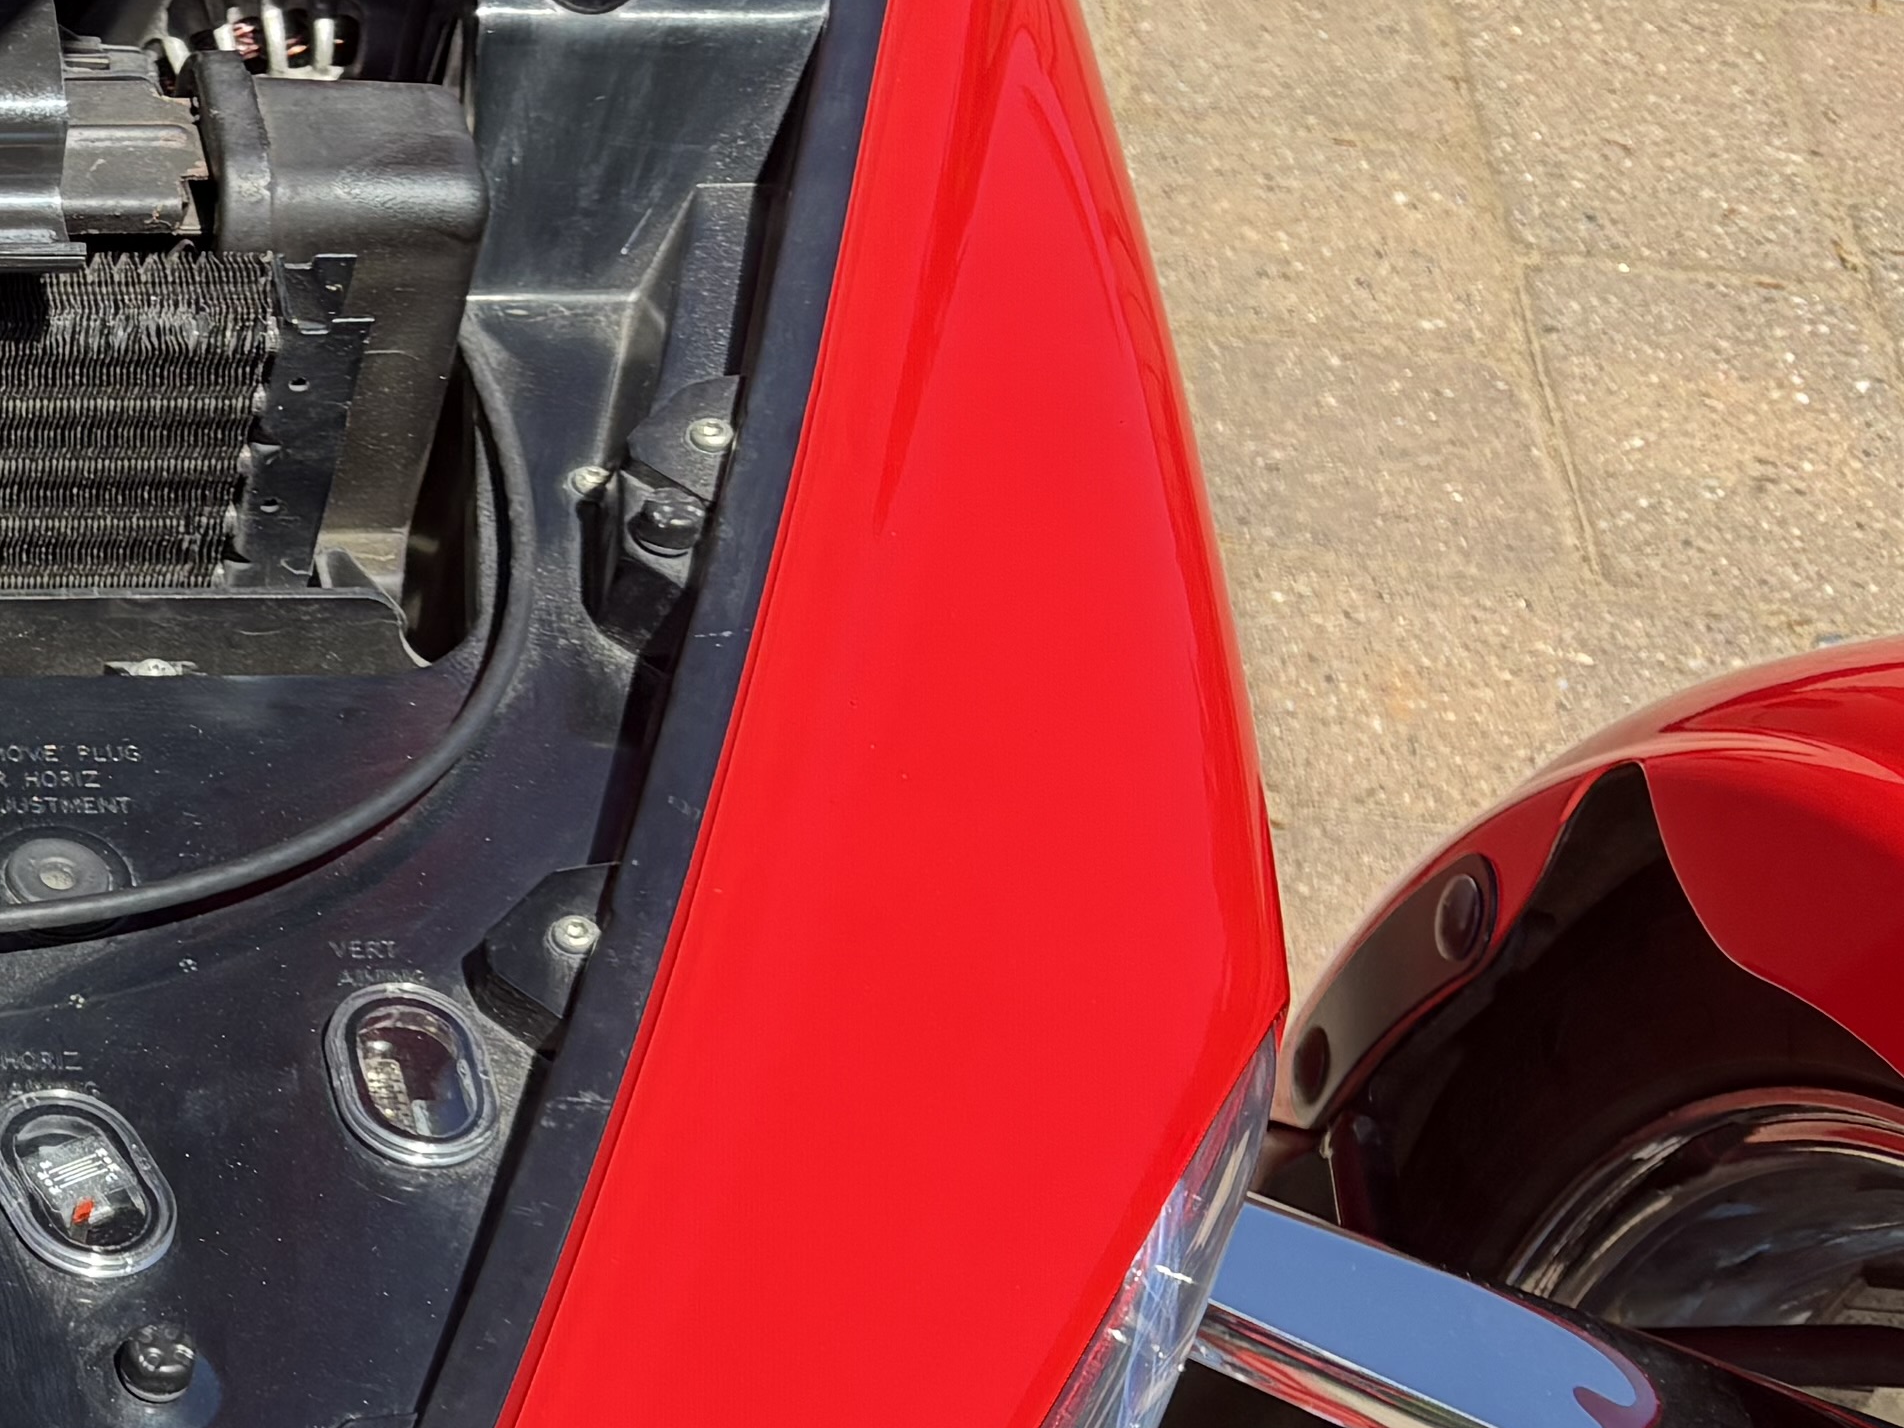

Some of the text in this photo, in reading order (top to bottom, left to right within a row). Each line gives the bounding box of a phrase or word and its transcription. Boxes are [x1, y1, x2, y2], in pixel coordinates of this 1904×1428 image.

[77, 744, 142, 762] PLUG
[24, 771, 100, 787] HORIZ
[328, 940, 395, 958] VERT
